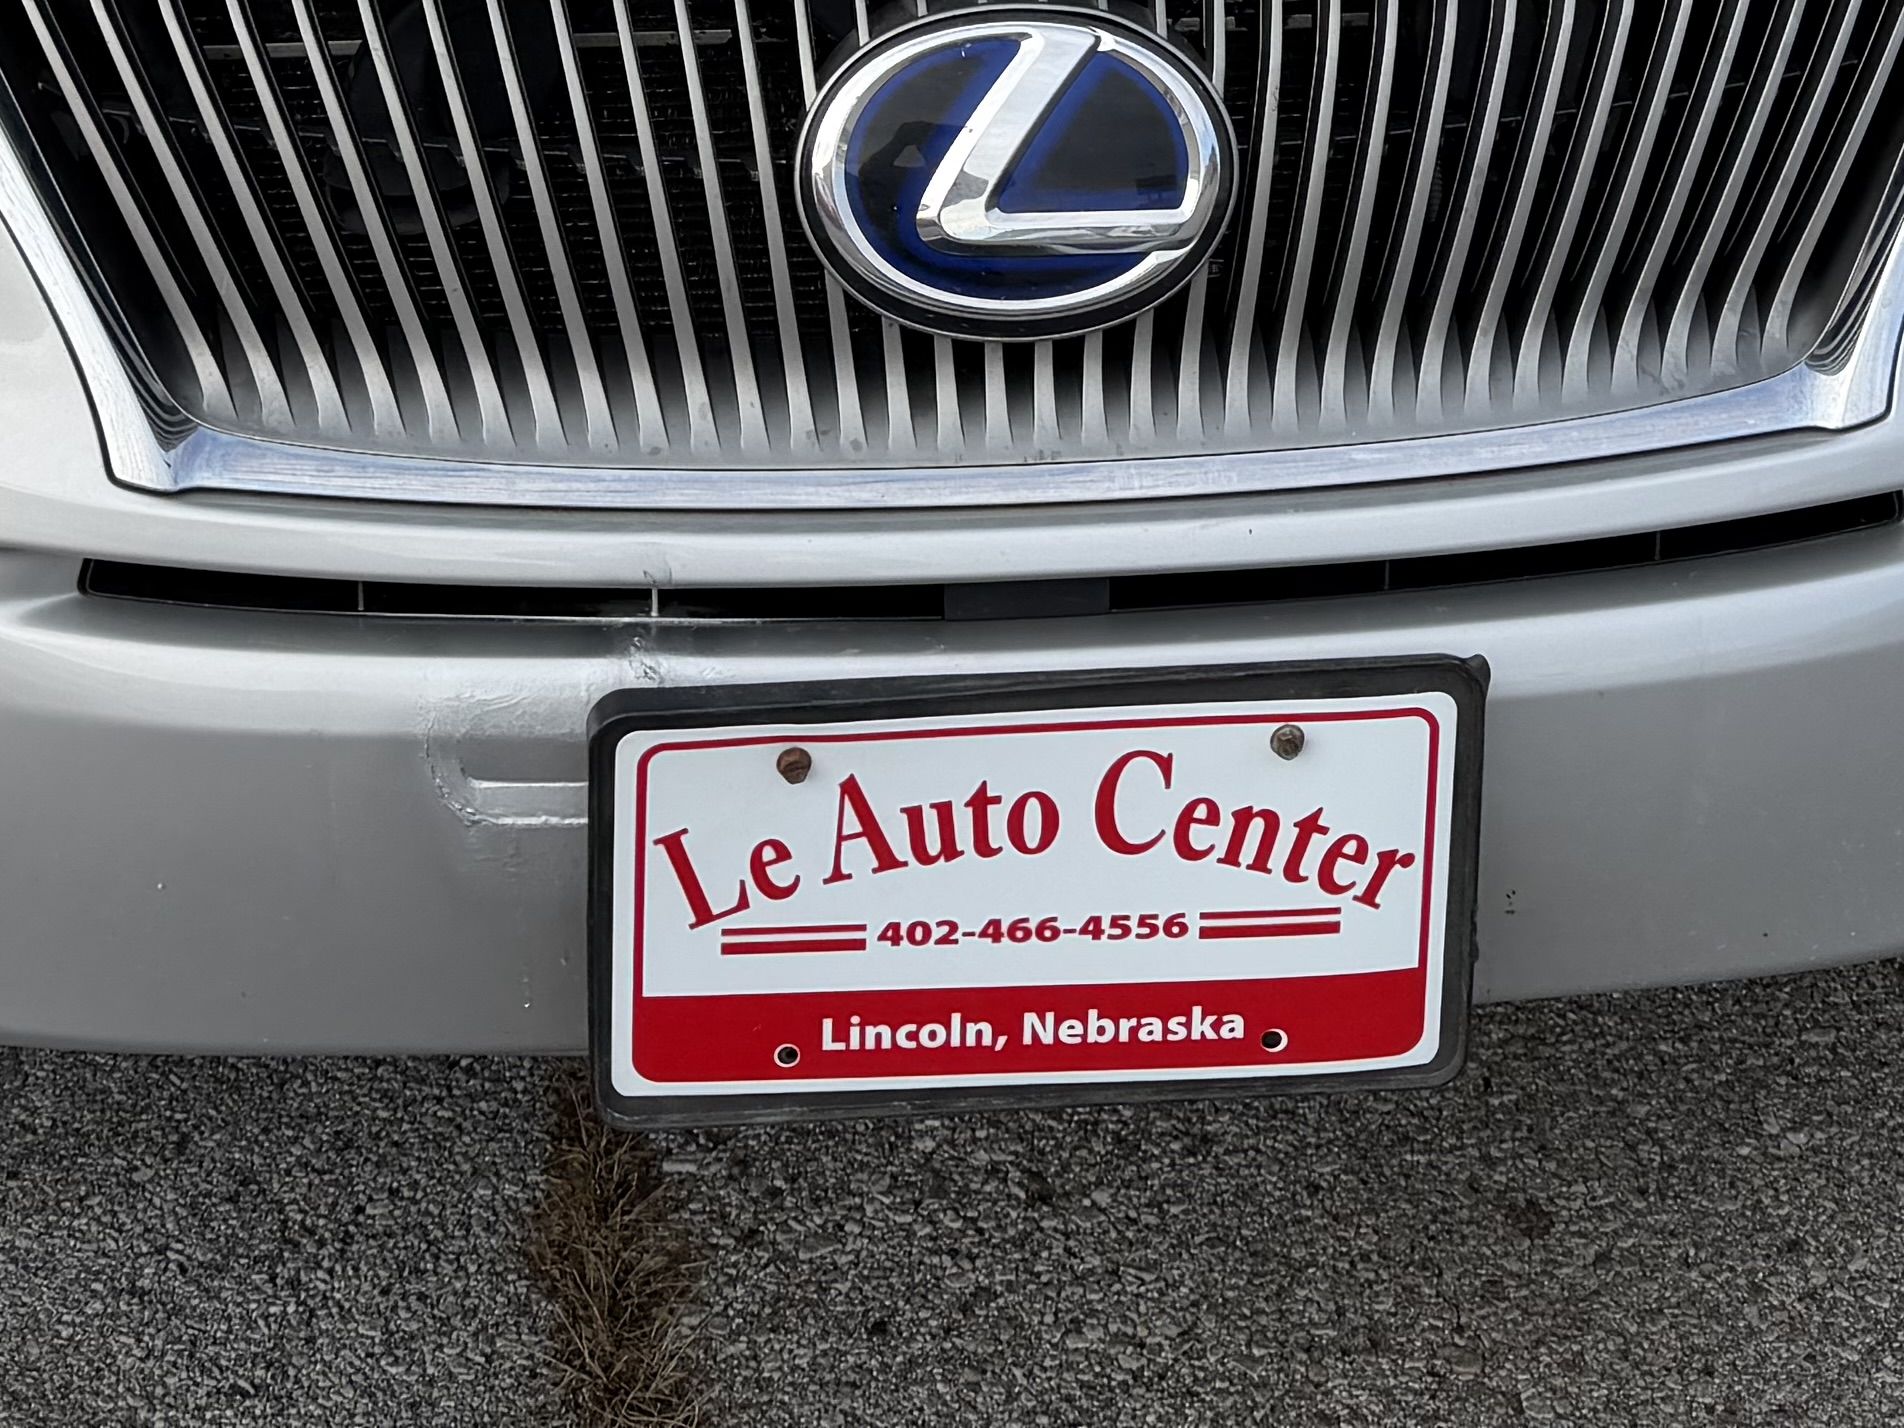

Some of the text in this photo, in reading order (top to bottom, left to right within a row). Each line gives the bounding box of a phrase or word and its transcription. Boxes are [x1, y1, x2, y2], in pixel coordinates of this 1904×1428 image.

[652, 749, 1416, 930] Le Auto Center
[876, 912, 1190, 948] 402-466-4556
[821, 1005, 1246, 1052] Lincoln, Nebraska
